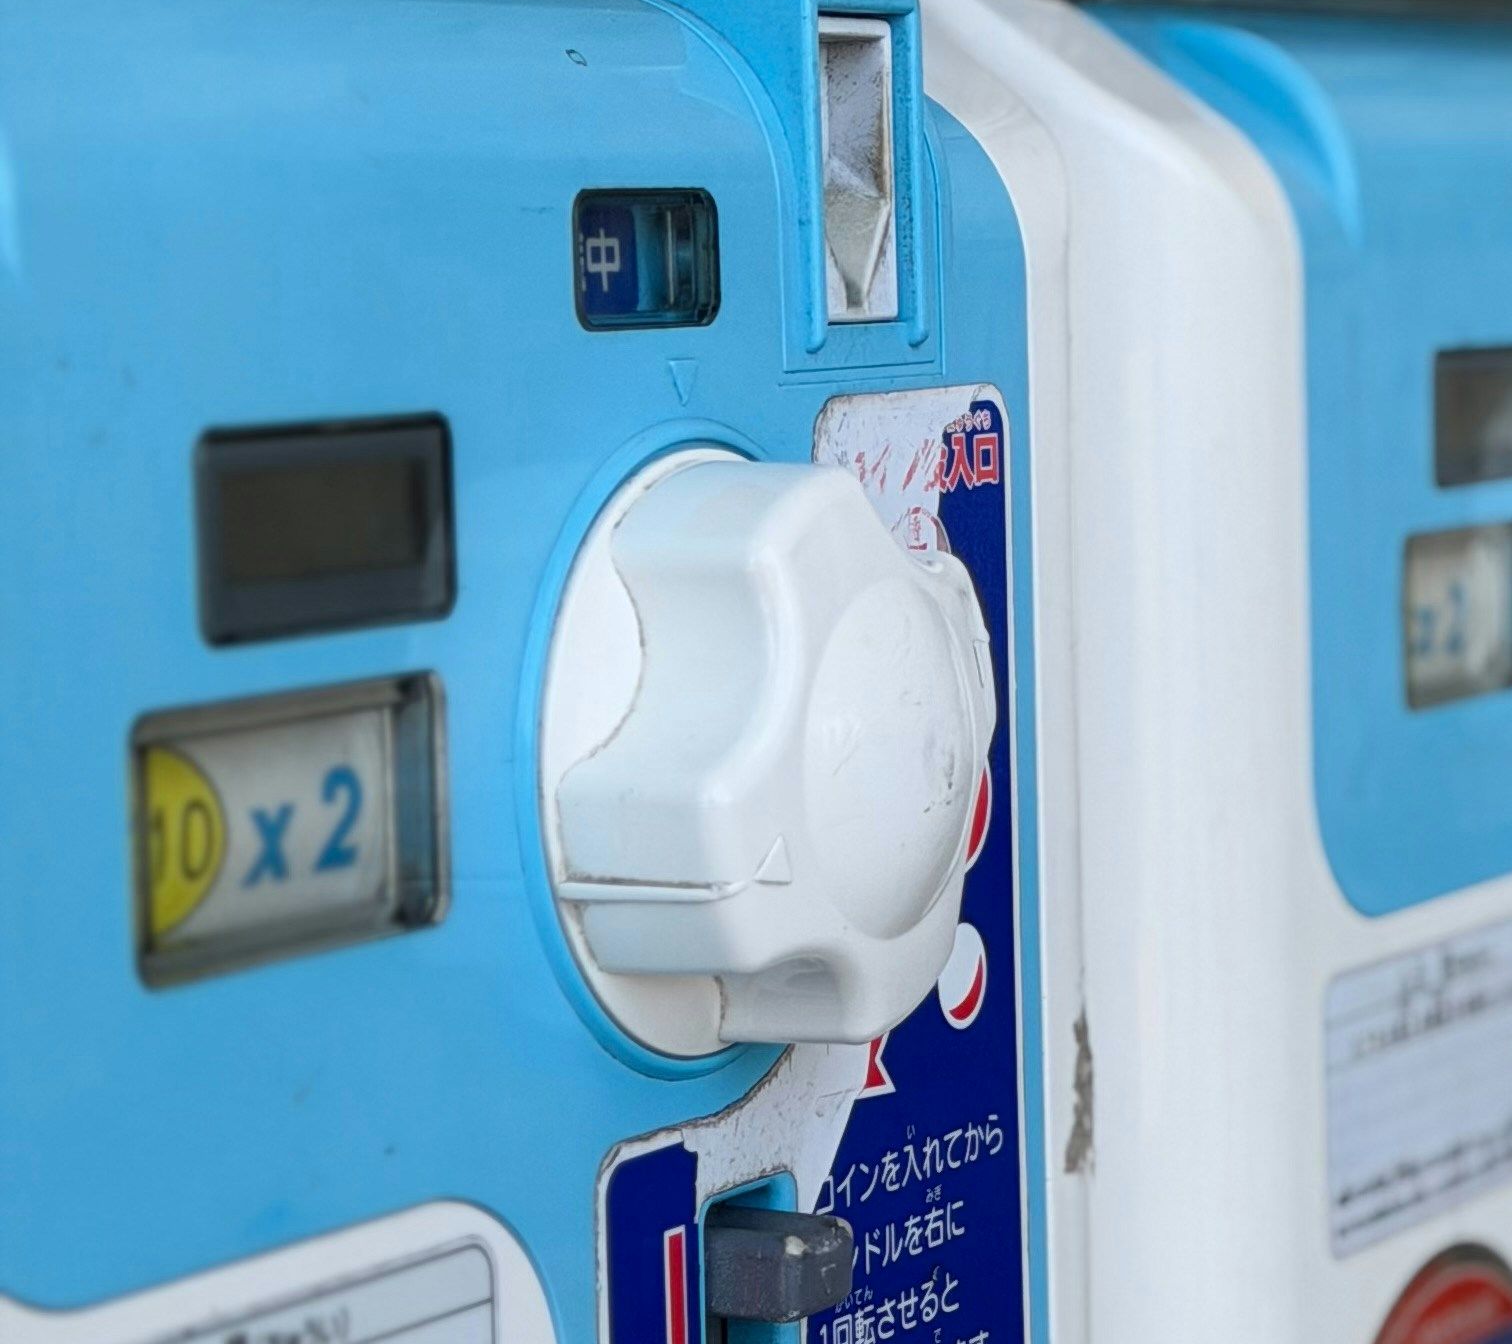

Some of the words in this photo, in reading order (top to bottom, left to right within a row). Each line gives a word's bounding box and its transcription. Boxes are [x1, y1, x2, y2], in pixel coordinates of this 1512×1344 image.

[816, 1114, 1004, 1216] コインを入れてから
